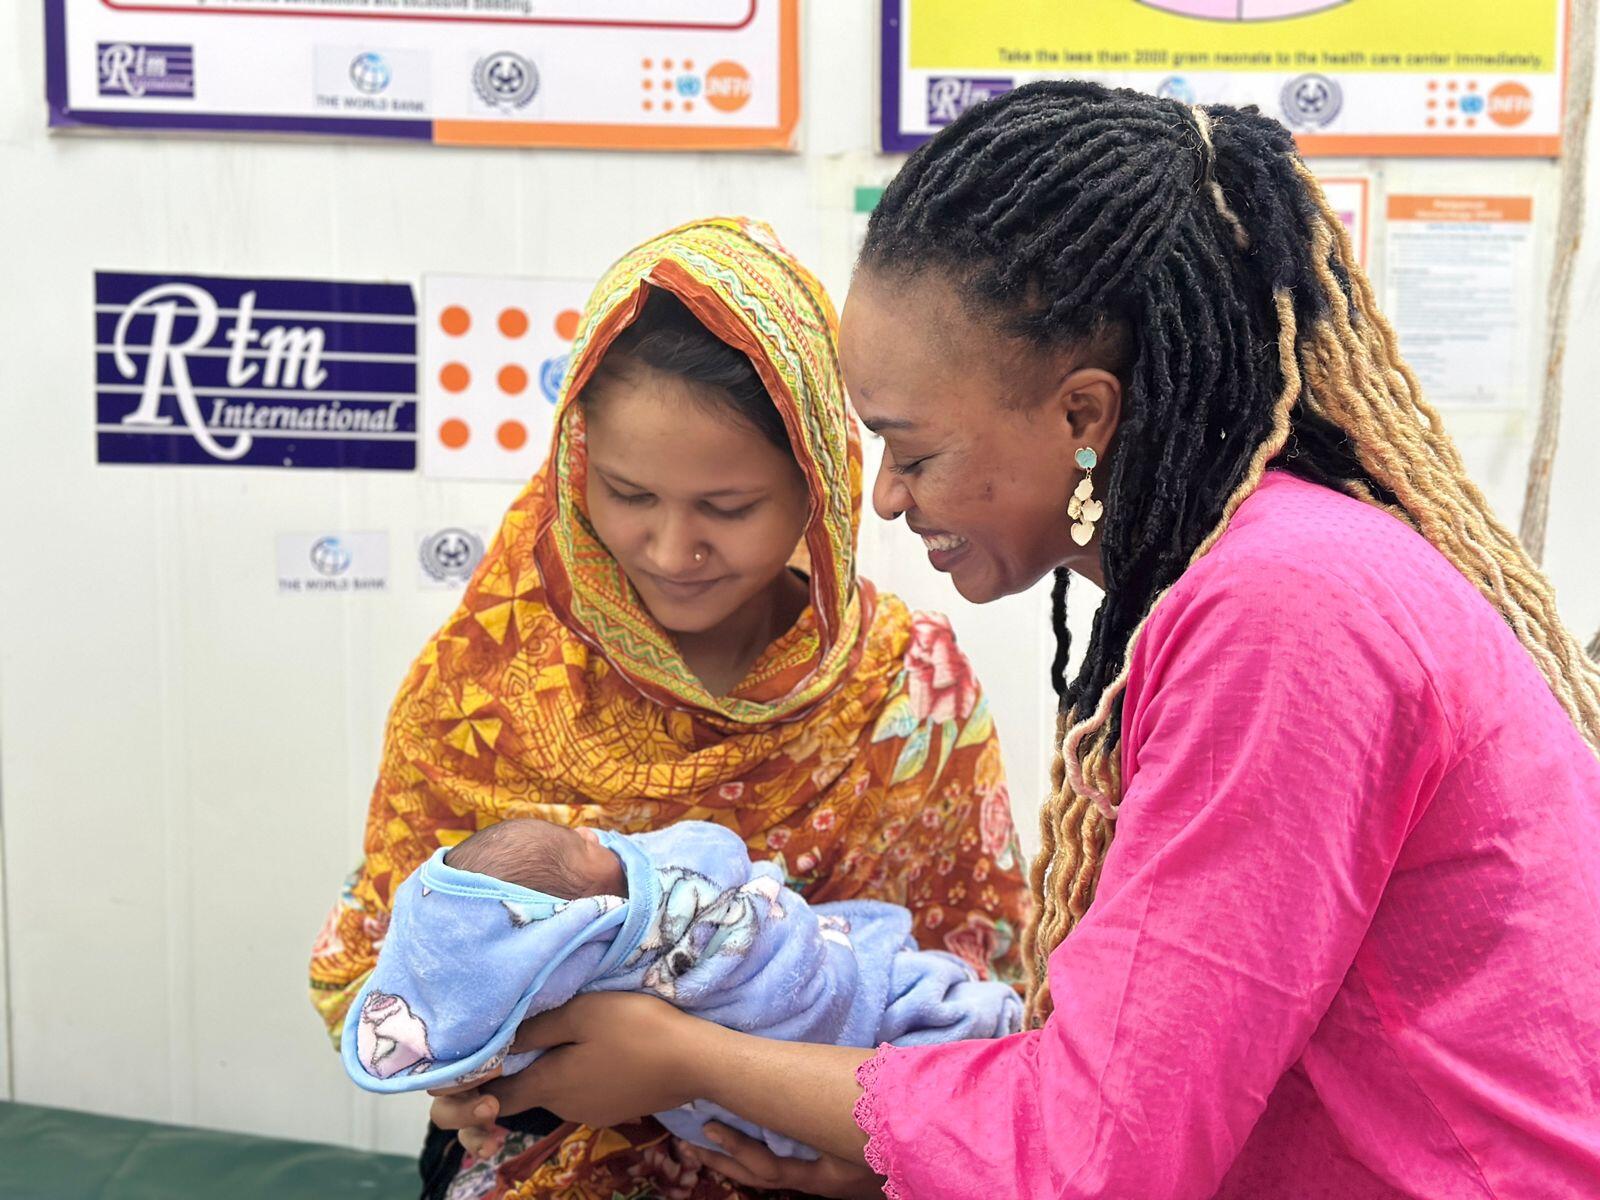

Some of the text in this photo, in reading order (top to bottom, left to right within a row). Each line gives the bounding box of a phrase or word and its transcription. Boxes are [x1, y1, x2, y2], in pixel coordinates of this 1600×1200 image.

[1036, 49, 1059, 64] the
[1098, 49, 1128, 64] than
[1173, 54, 1209, 68] gram
[1277, 51, 1289, 66] to
[1295, 51, 1317, 66] the
[1324, 52, 1365, 67] health
[1371, 56, 1401, 67] care
[1407, 55, 1451, 68] center
[113, 283, 328, 460] Rtm
[208, 399, 405, 432] International
